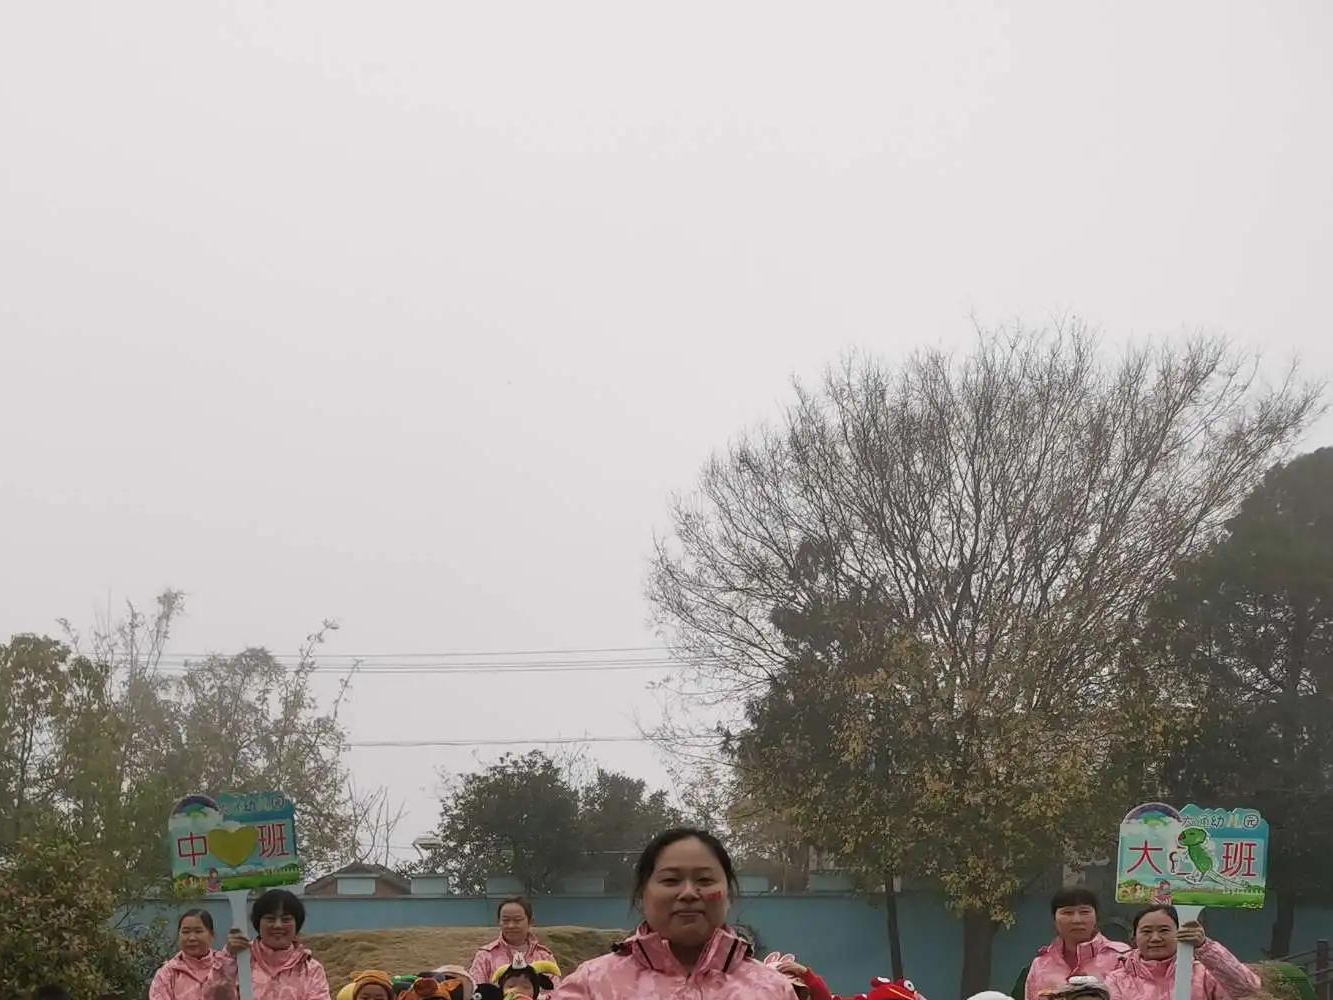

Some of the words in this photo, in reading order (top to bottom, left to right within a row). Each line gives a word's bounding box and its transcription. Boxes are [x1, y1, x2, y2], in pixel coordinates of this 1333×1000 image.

[177, 831, 208, 867] 中
[257, 823, 290, 858] 班
[1126, 839, 1164, 875] 大
[1219, 841, 1258, 877] 班
